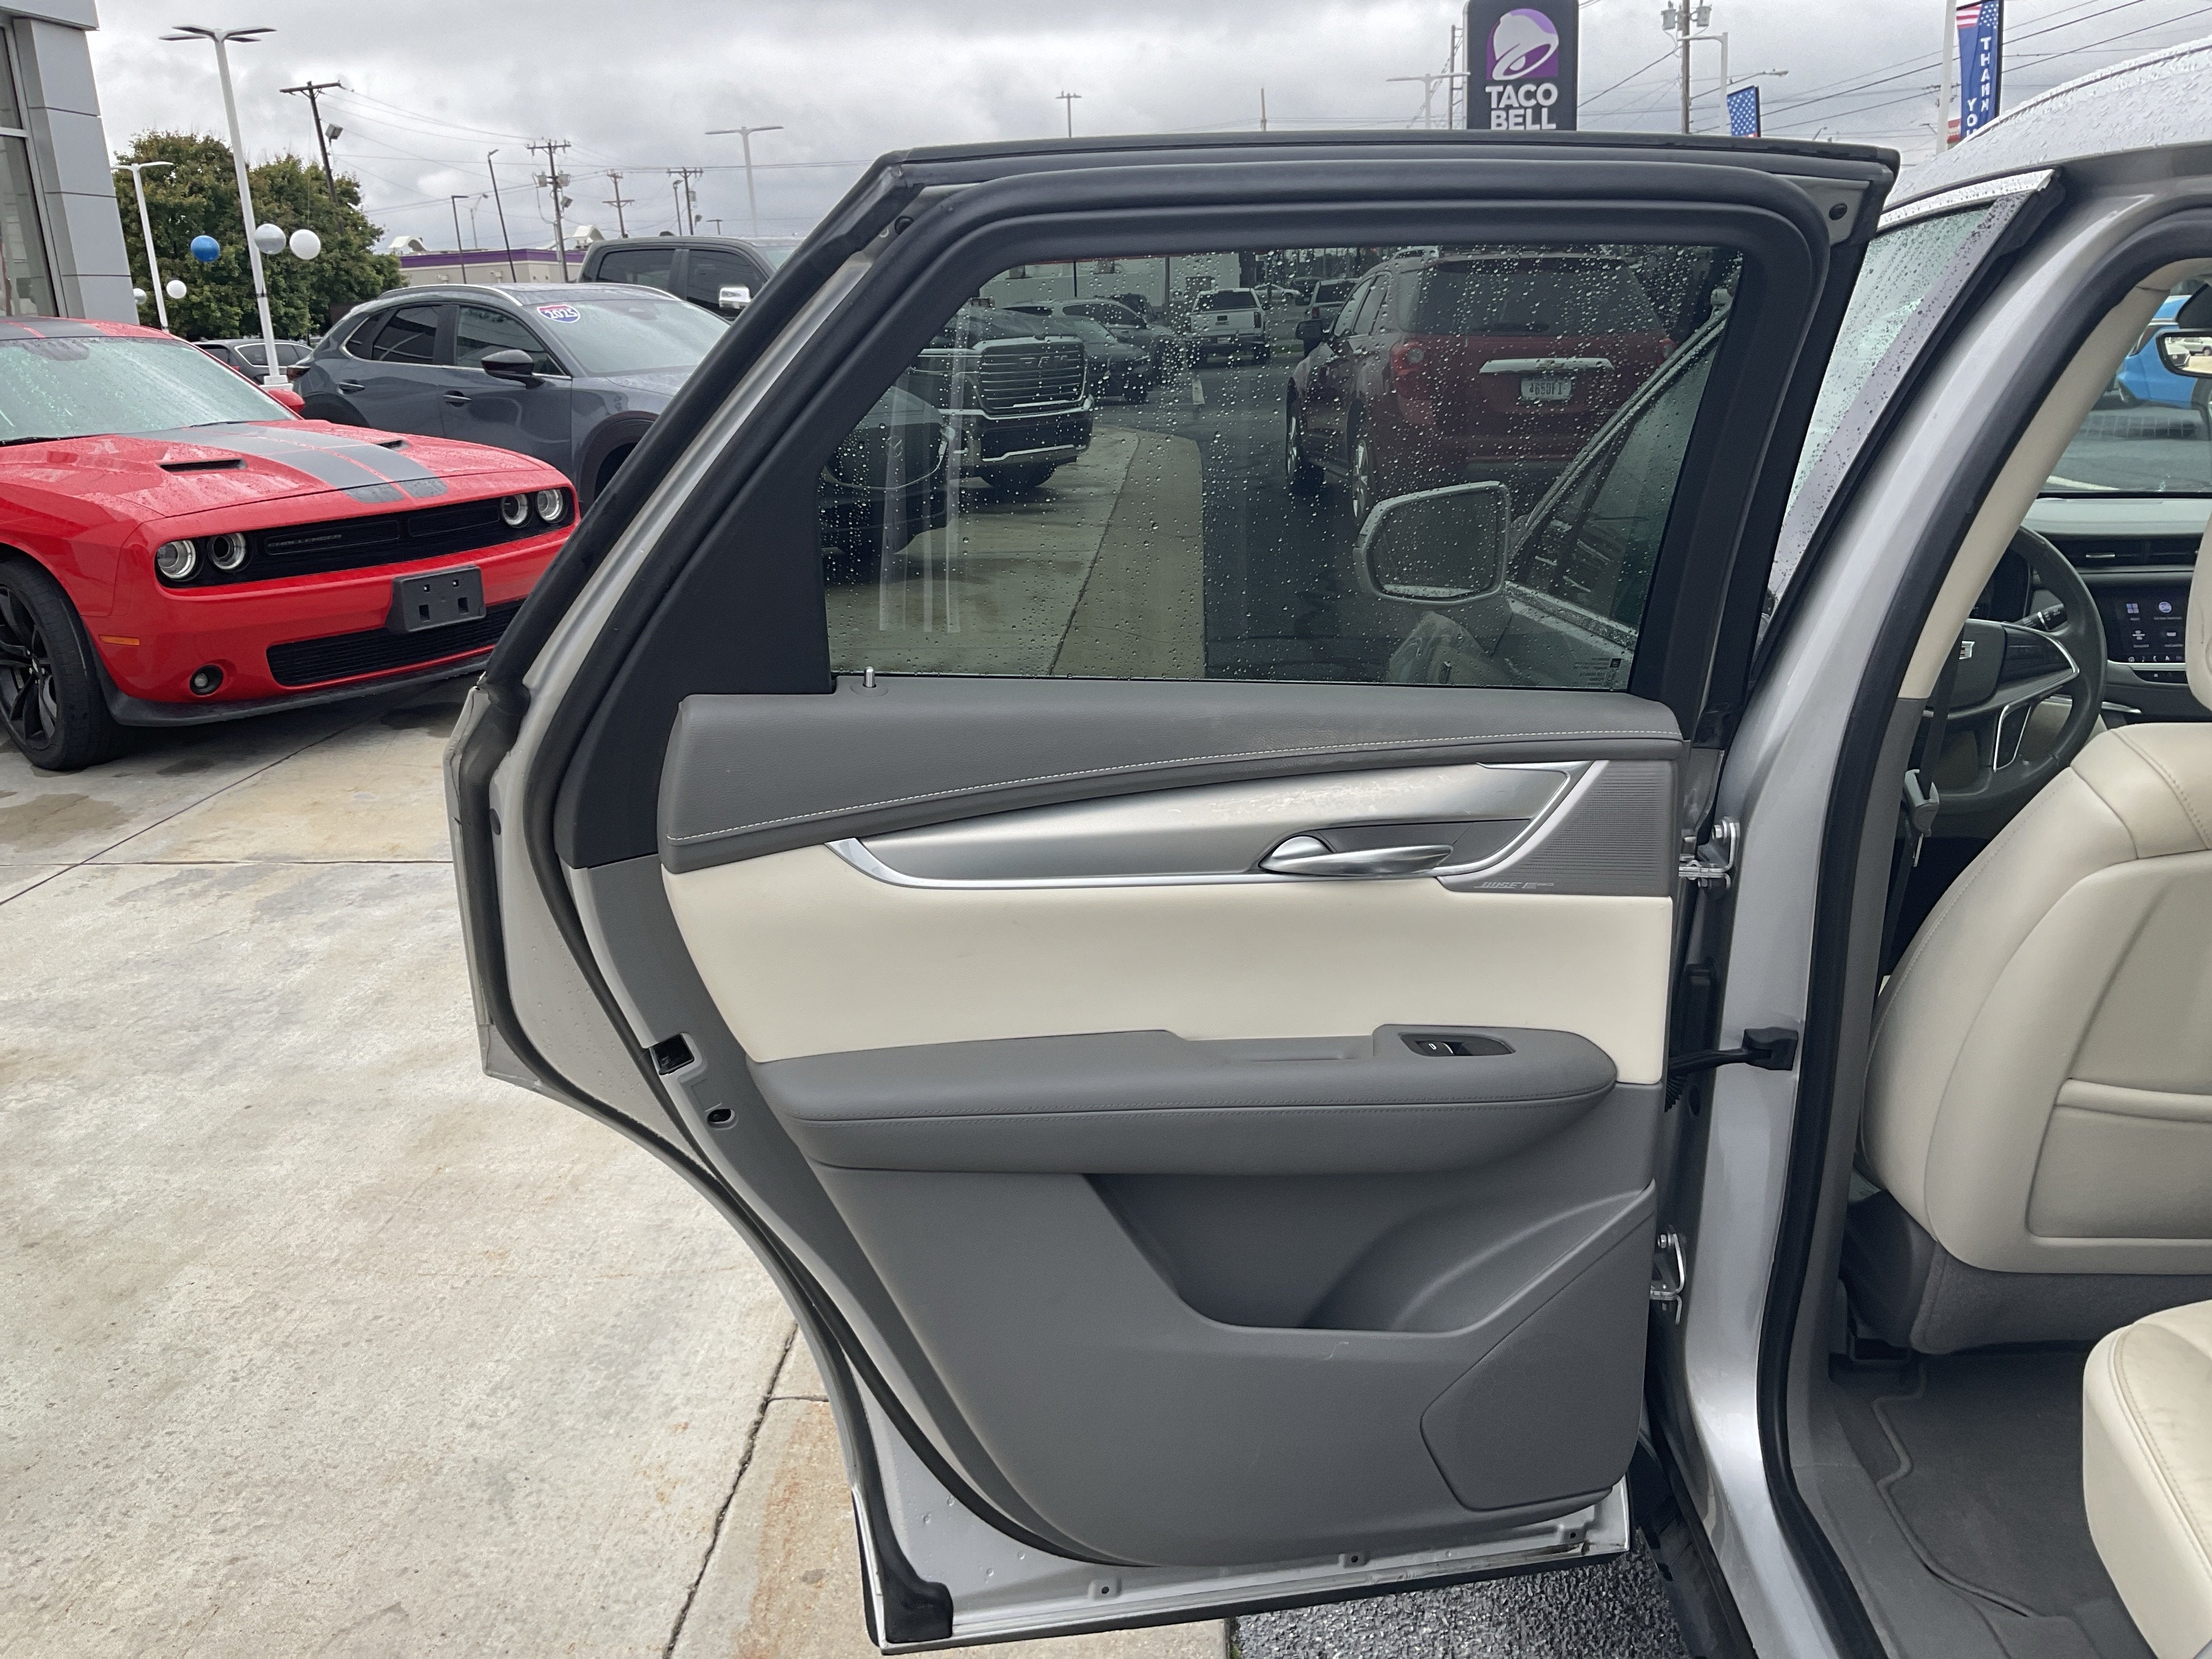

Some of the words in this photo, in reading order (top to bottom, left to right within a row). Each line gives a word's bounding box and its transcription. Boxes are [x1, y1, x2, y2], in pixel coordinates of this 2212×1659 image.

[1980, 36, 1992, 112] THANK
[1485, 82, 1558, 109] TACO
[1491, 108, 1556, 131] BELL
[545, 308, 577, 319] 2025
